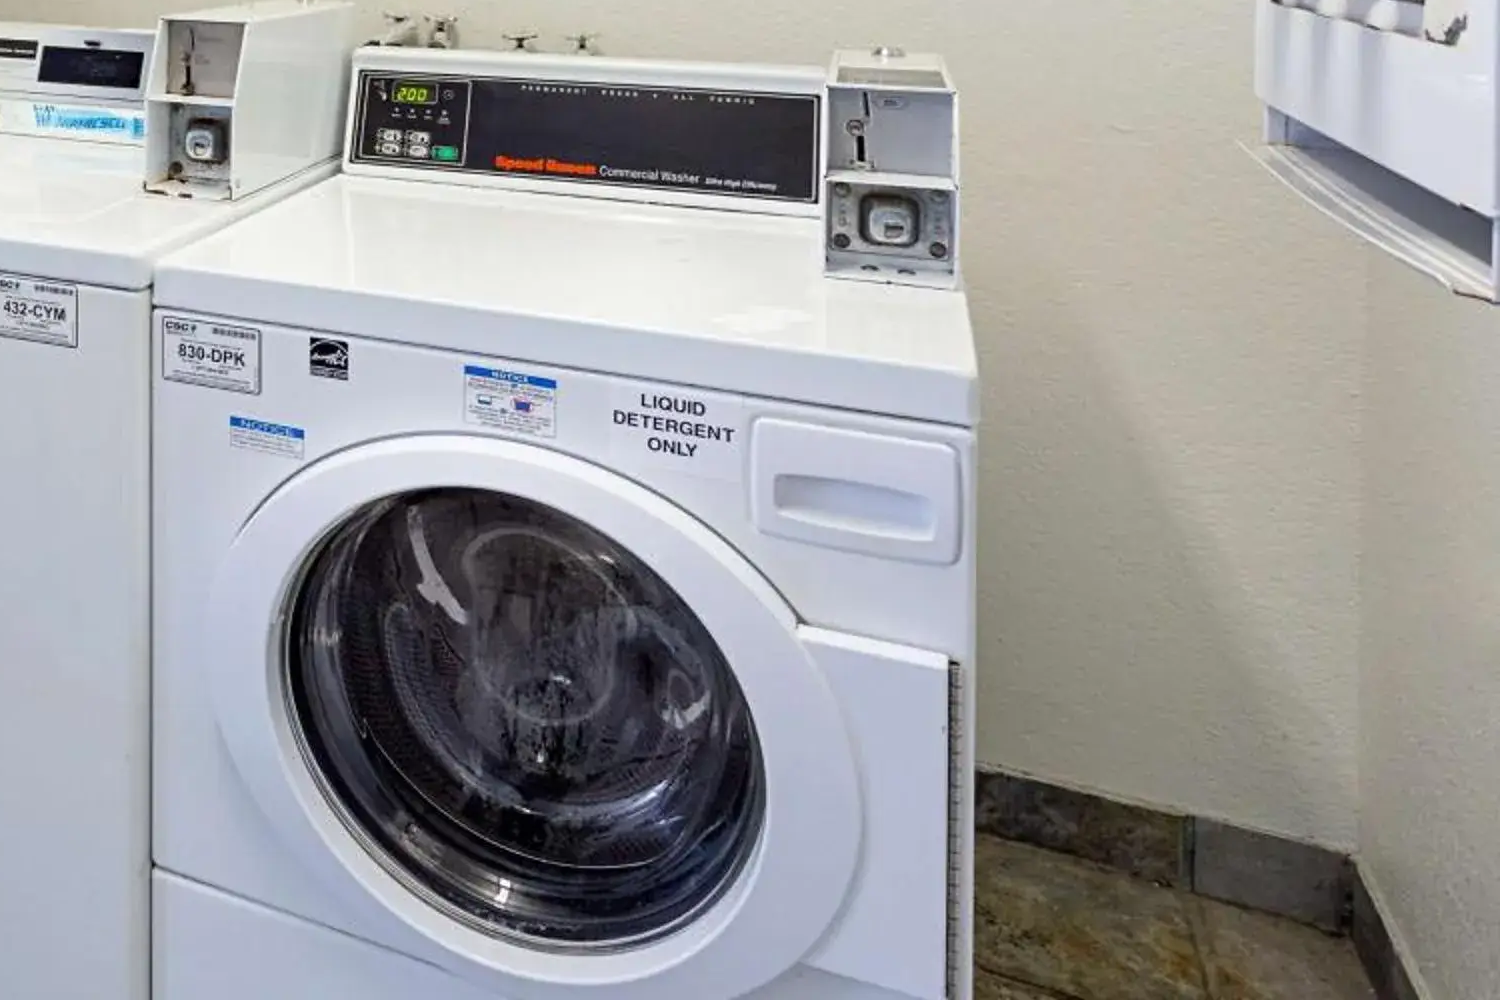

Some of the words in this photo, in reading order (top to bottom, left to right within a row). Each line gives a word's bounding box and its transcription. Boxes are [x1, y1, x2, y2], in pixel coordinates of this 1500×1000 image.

[397, 87, 429, 102] 200
[600, 163, 659, 181] Commercial
[660, 169, 700, 185] Washer
[3, 299, 67, 322] 432-CYM
[178, 342, 246, 368] 830-DPK
[640, 392, 707, 417] LIQUID
[612, 408, 736, 442] DETERGENT
[647, 436, 698, 458] ONLY
